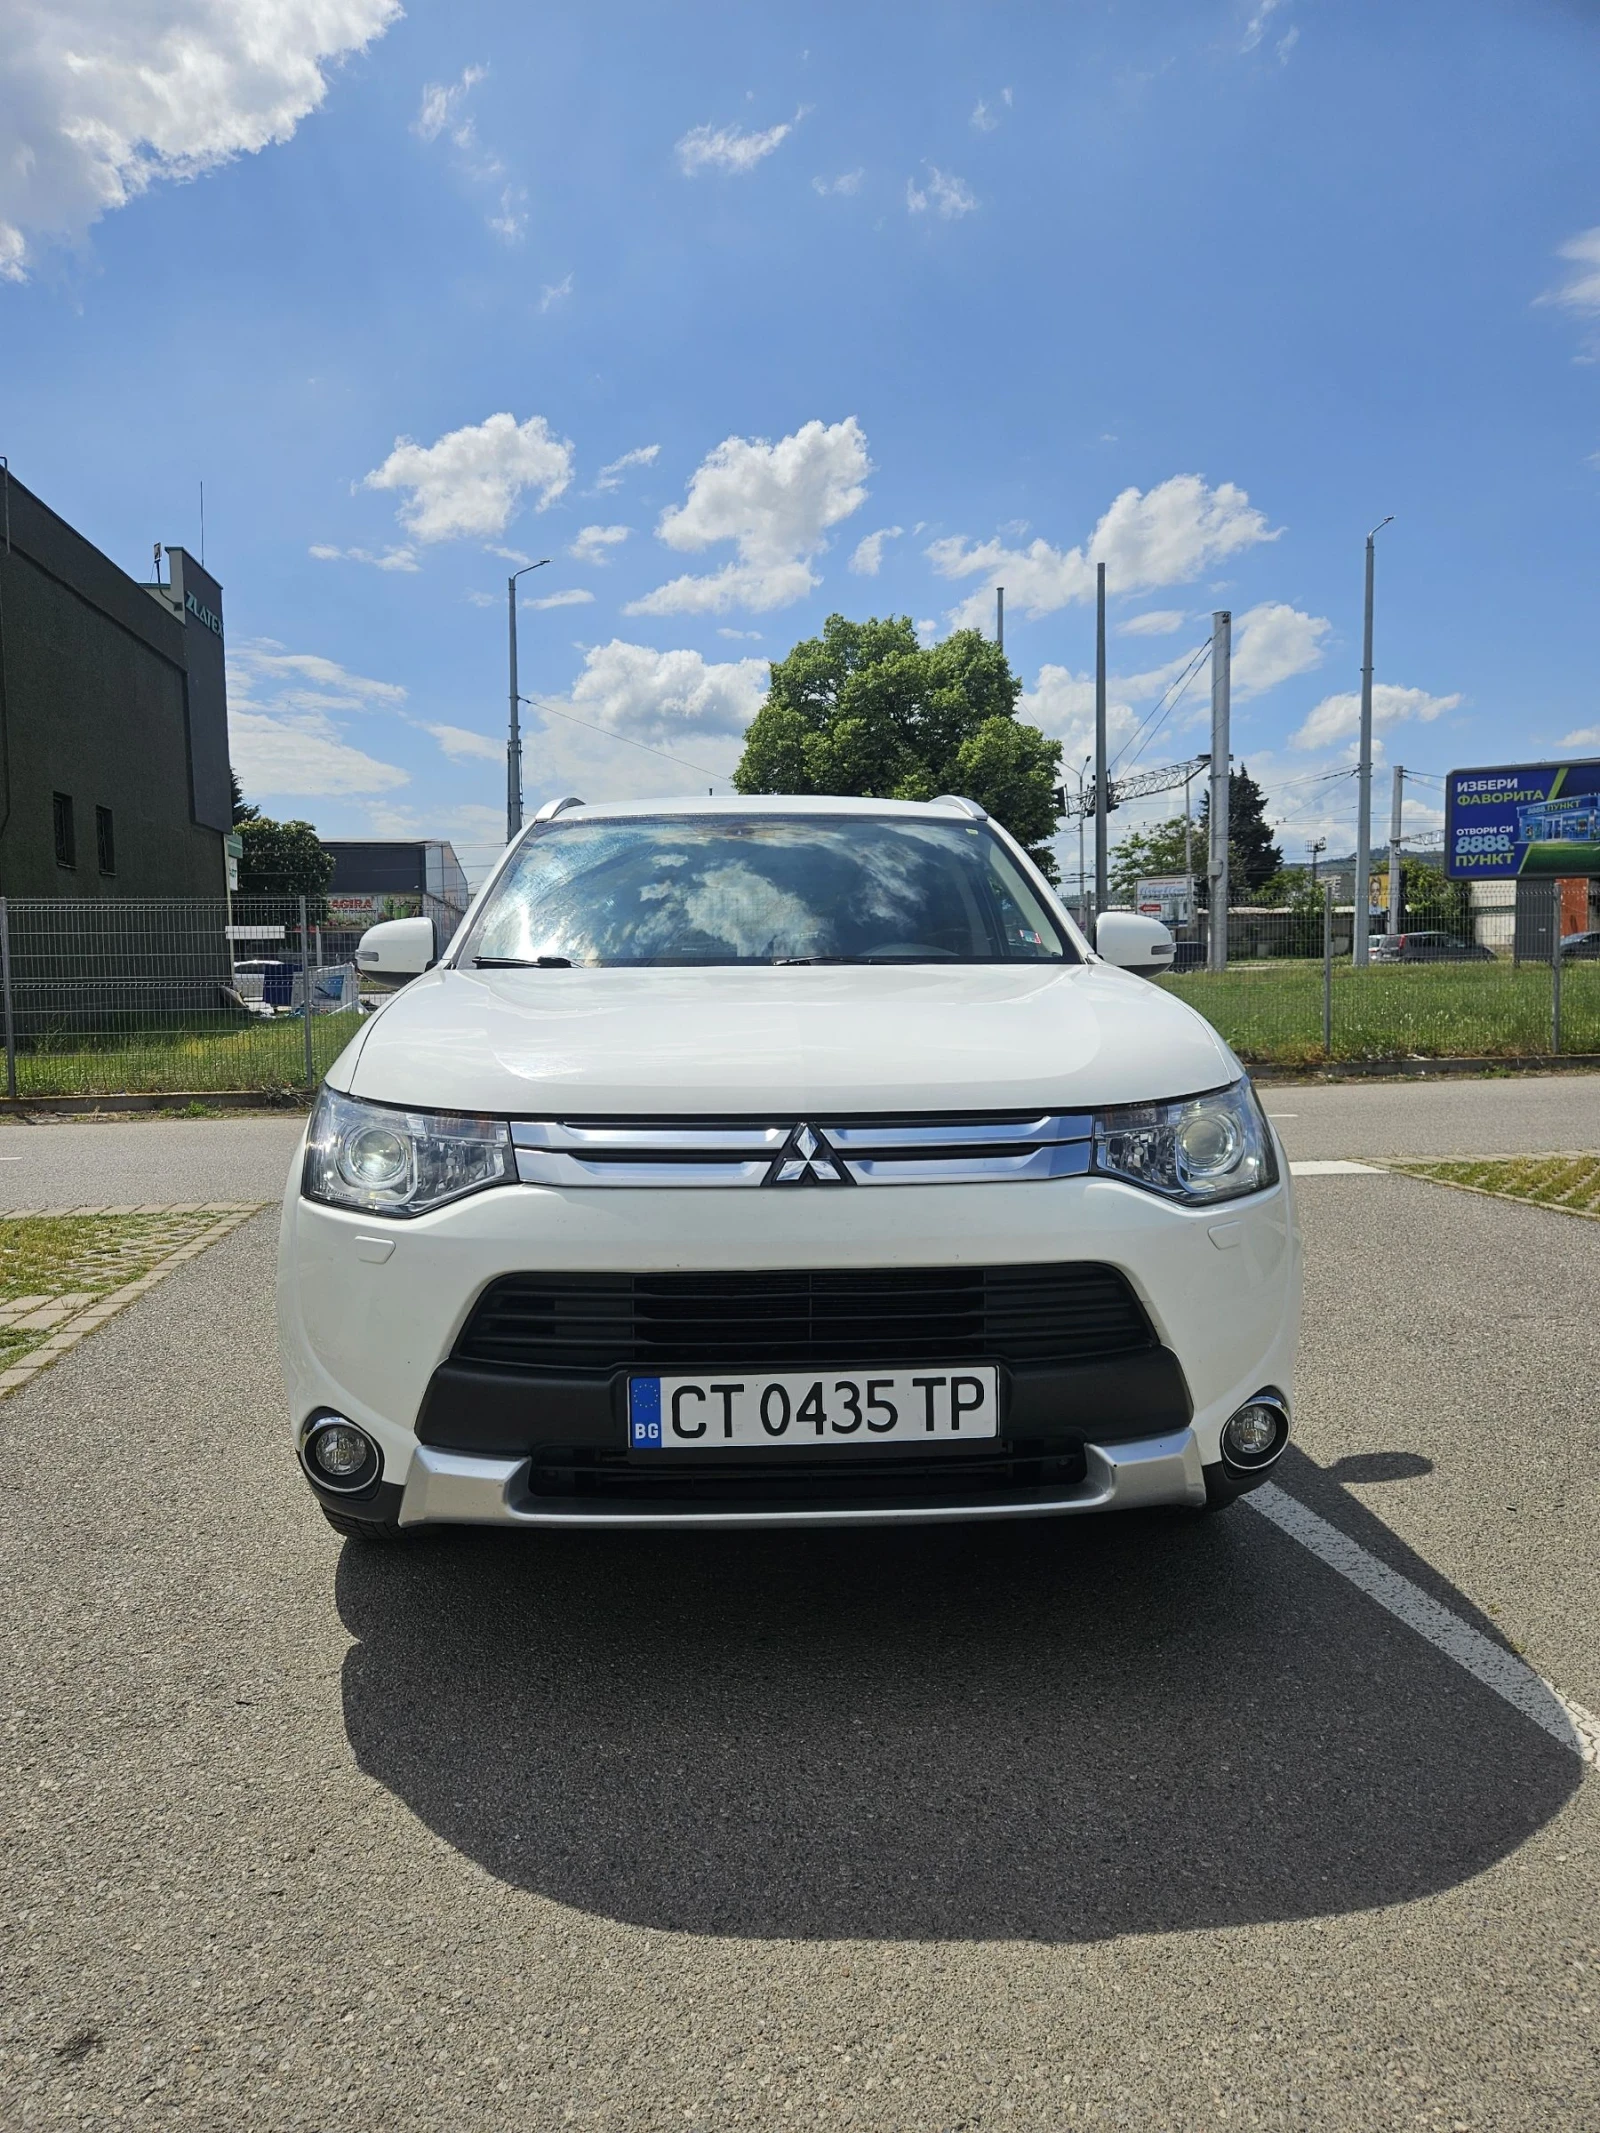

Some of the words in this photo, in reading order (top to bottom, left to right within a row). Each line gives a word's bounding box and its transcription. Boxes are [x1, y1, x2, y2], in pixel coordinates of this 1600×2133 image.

[1457, 778, 1518, 792] ИЗБЕРИ
[1457, 790, 1544, 806] ФАВОРИТА
[1547, 800, 1581, 811] ПУНКТ
[1456, 827, 1497, 836] ОТВОРИ
[1499, 825, 1514, 834] СИ
[1455, 853, 1515, 867] ПУНКТ
[671, 1383, 745, 1439] CT
[760, 1379, 898, 1437] 0435
[912, 1376, 985, 1432] TP
[635, 1423, 659, 1439] BG
